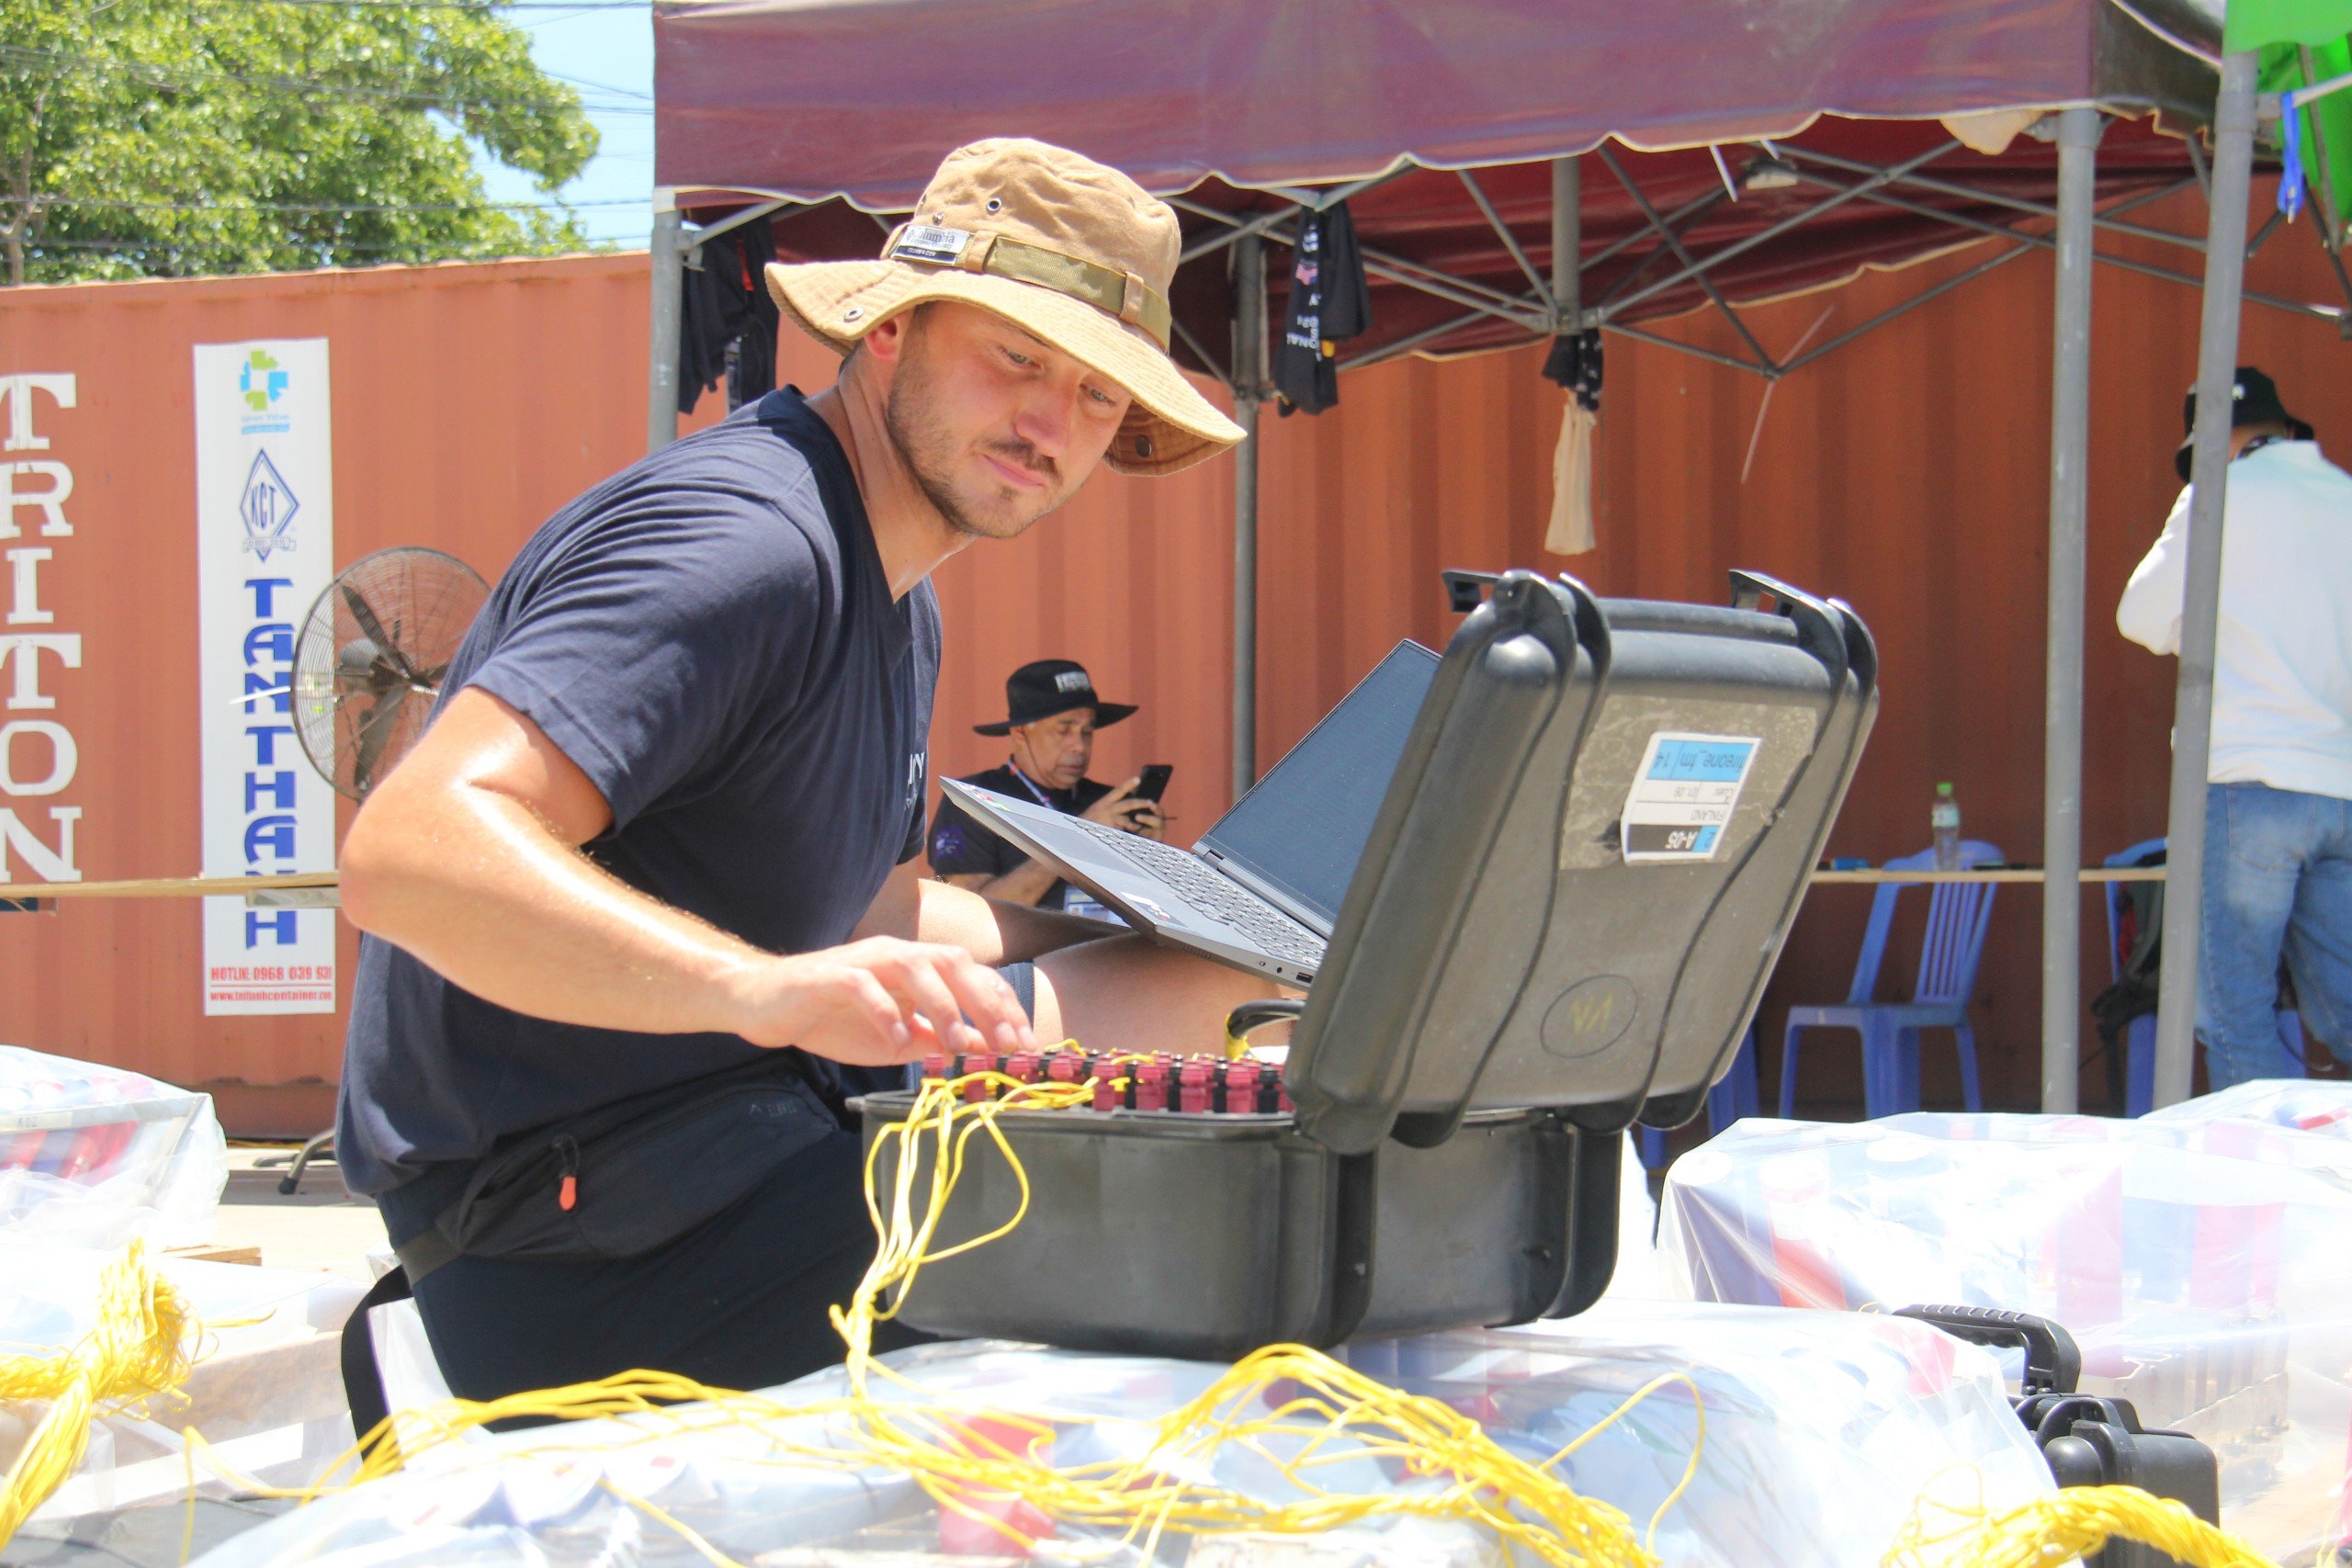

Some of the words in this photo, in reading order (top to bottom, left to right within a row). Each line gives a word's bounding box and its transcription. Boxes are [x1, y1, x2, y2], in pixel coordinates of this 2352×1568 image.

[0, 373, 83, 883] TRITON
[243, 578, 299, 950] TANTHAH
[1654, 751, 1671, 772] 14
[1690, 808, 1725, 822] FINLAND
[1665, 829, 1698, 850] A-05
[1703, 831, 1716, 849] 2
